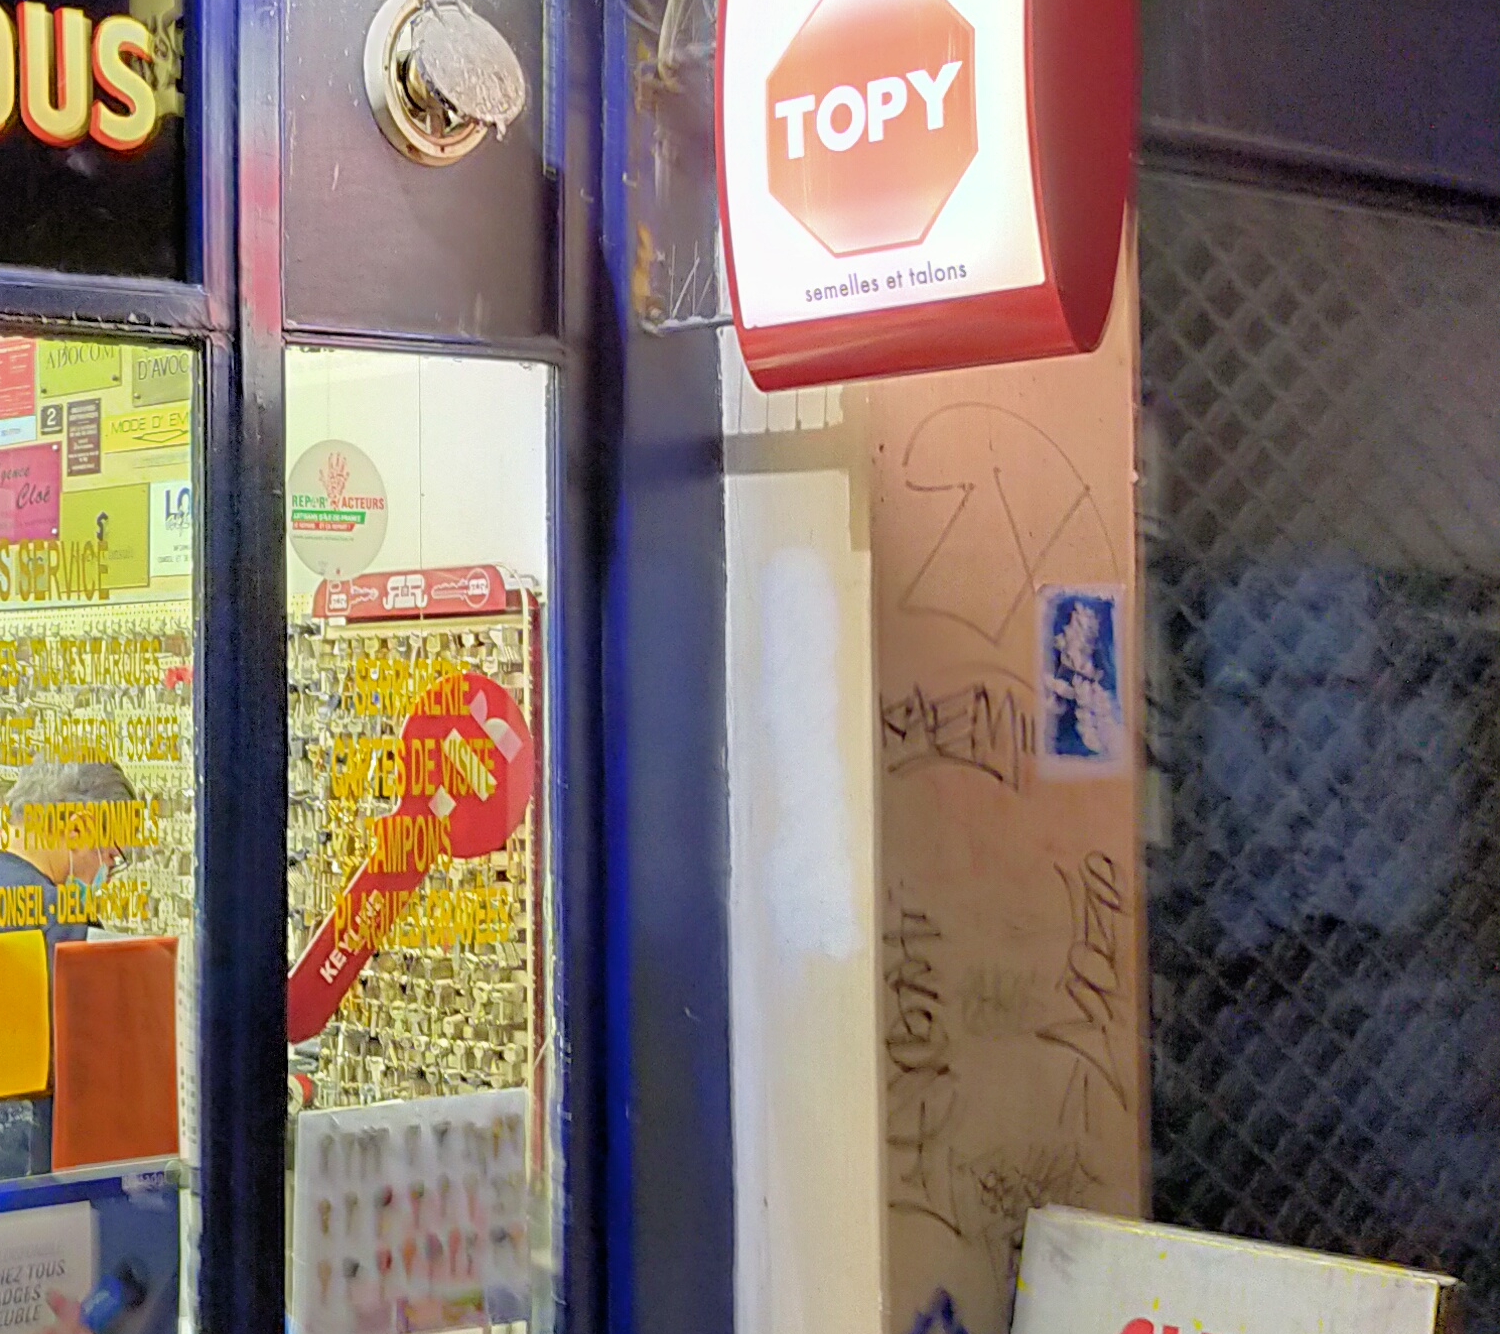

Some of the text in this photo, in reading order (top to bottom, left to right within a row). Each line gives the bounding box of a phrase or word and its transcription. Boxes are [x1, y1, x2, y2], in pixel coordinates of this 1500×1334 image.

[775, 61, 963, 160] TOPY
[805, 262, 967, 303] semelles et talons
[46, 408, 56, 425] 2
[19, 539, 110, 601] SERVICE
[88, 637, 161, 686] MARQUES
[355, 657, 470, 716] SERRURERIE
[332, 735, 496, 800] CARTES DE VISITE
[23, 800, 159, 851] PROFESSIONNELS
[364, 815, 451, 873] TAMPONS
[28, 1259, 66, 1279] TOUS
